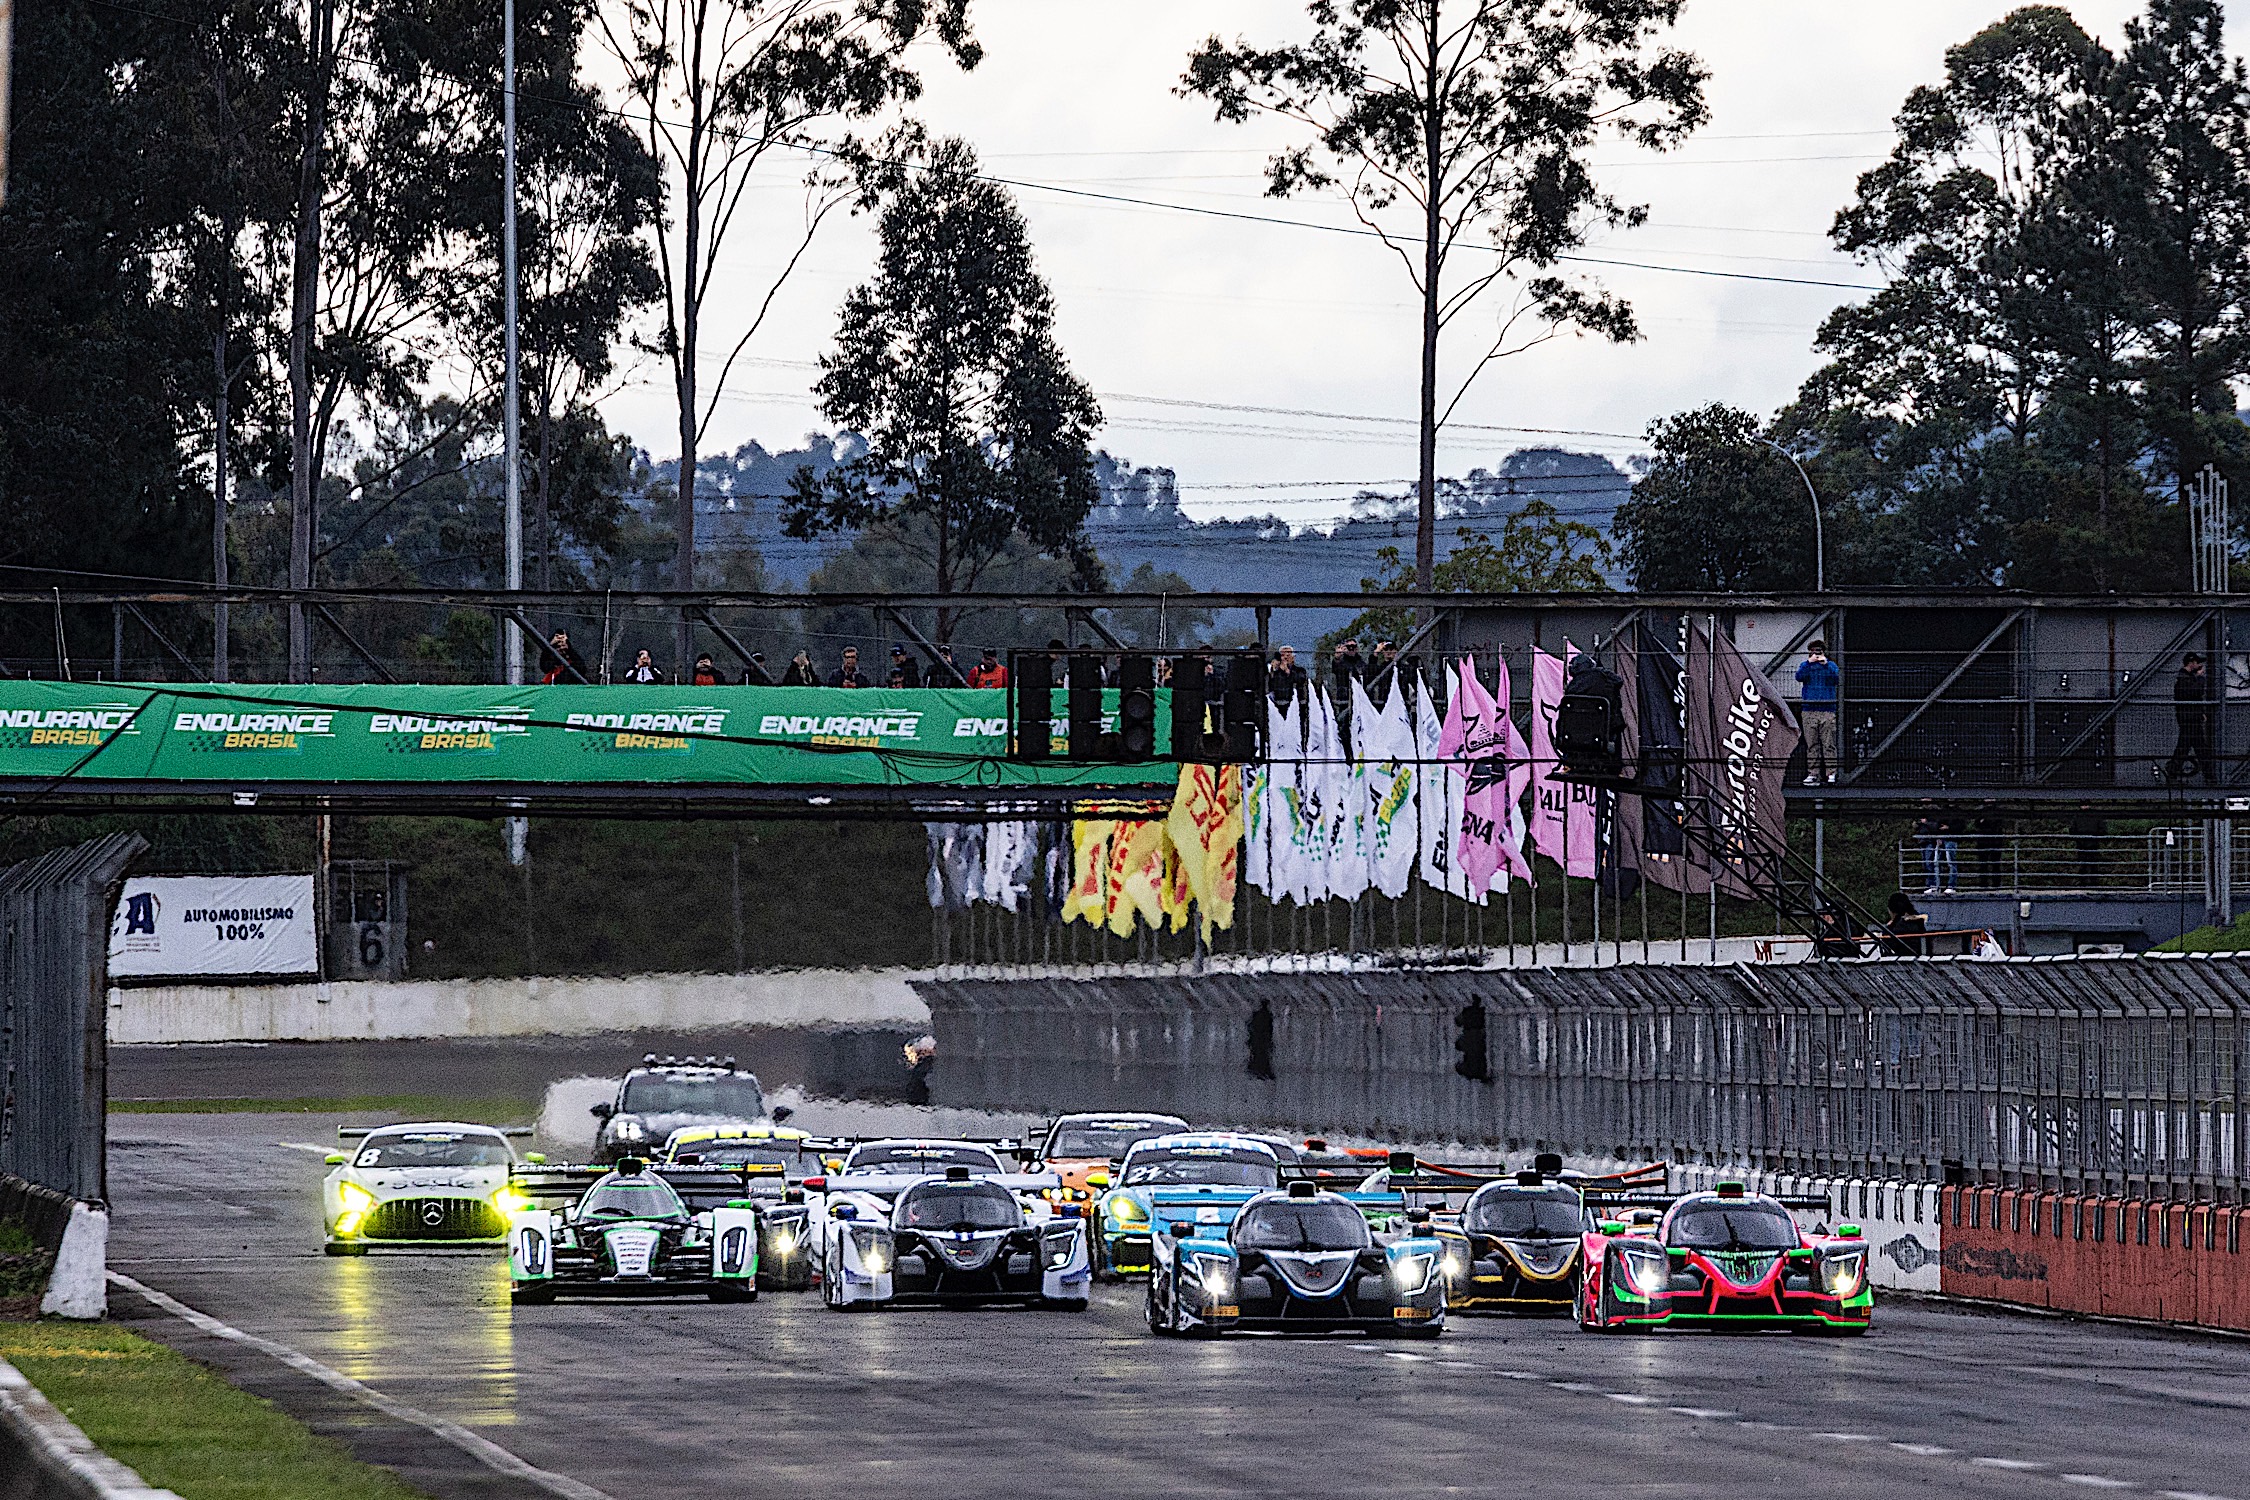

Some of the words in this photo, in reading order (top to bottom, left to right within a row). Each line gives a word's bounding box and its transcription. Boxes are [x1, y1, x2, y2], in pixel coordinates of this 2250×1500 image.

[0, 710, 134, 729] NDURANCE
[174, 713, 333, 732] ENDURANCE
[370, 714, 529, 732] ENDURANCE
[565, 714, 725, 733] ENDURANCE
[759, 716, 918, 736] ENDURANCE
[30, 730, 103, 745] BRASIL
[224, 733, 298, 748] BRASIL
[421, 735, 495, 749] BRASIL
[615, 734, 689, 749] BRASIL
[184, 907, 294, 923] AUTOMOBILISMO
[215, 922, 265, 940] 100%
[360, 923, 384, 967] 6
[356, 1148, 382, 1166] 8
